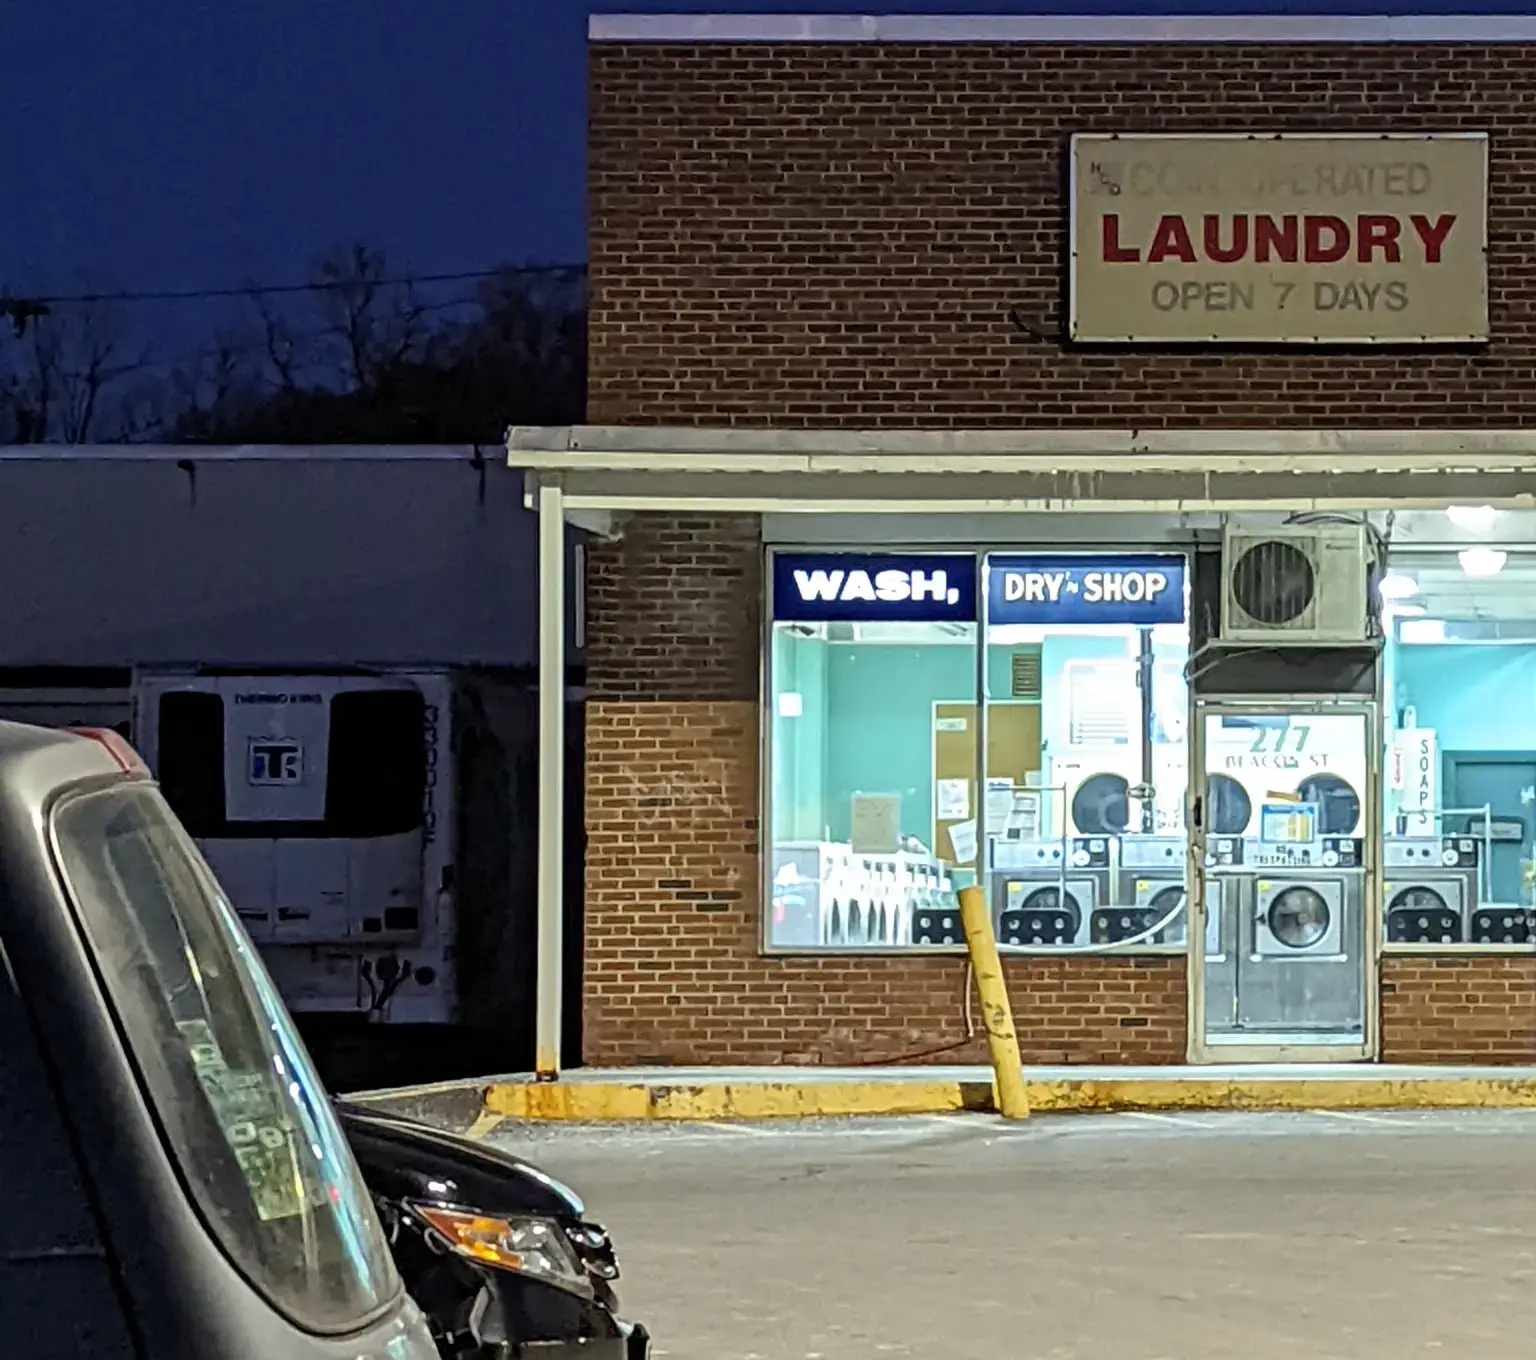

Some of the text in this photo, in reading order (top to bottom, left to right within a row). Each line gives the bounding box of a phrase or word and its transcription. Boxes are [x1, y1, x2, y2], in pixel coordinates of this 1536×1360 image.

[1254, 161, 1432, 196] PERATED
[1102, 213, 1457, 264] LAUNDRY
[1151, 279, 1410, 312] OPEN 7 DAYS
[793, 568, 960, 605] WASH,
[1083, 571, 1168, 602] SHOP
[1249, 725, 1311, 753] 277
[1418, 739, 1429, 825] SOAPS
